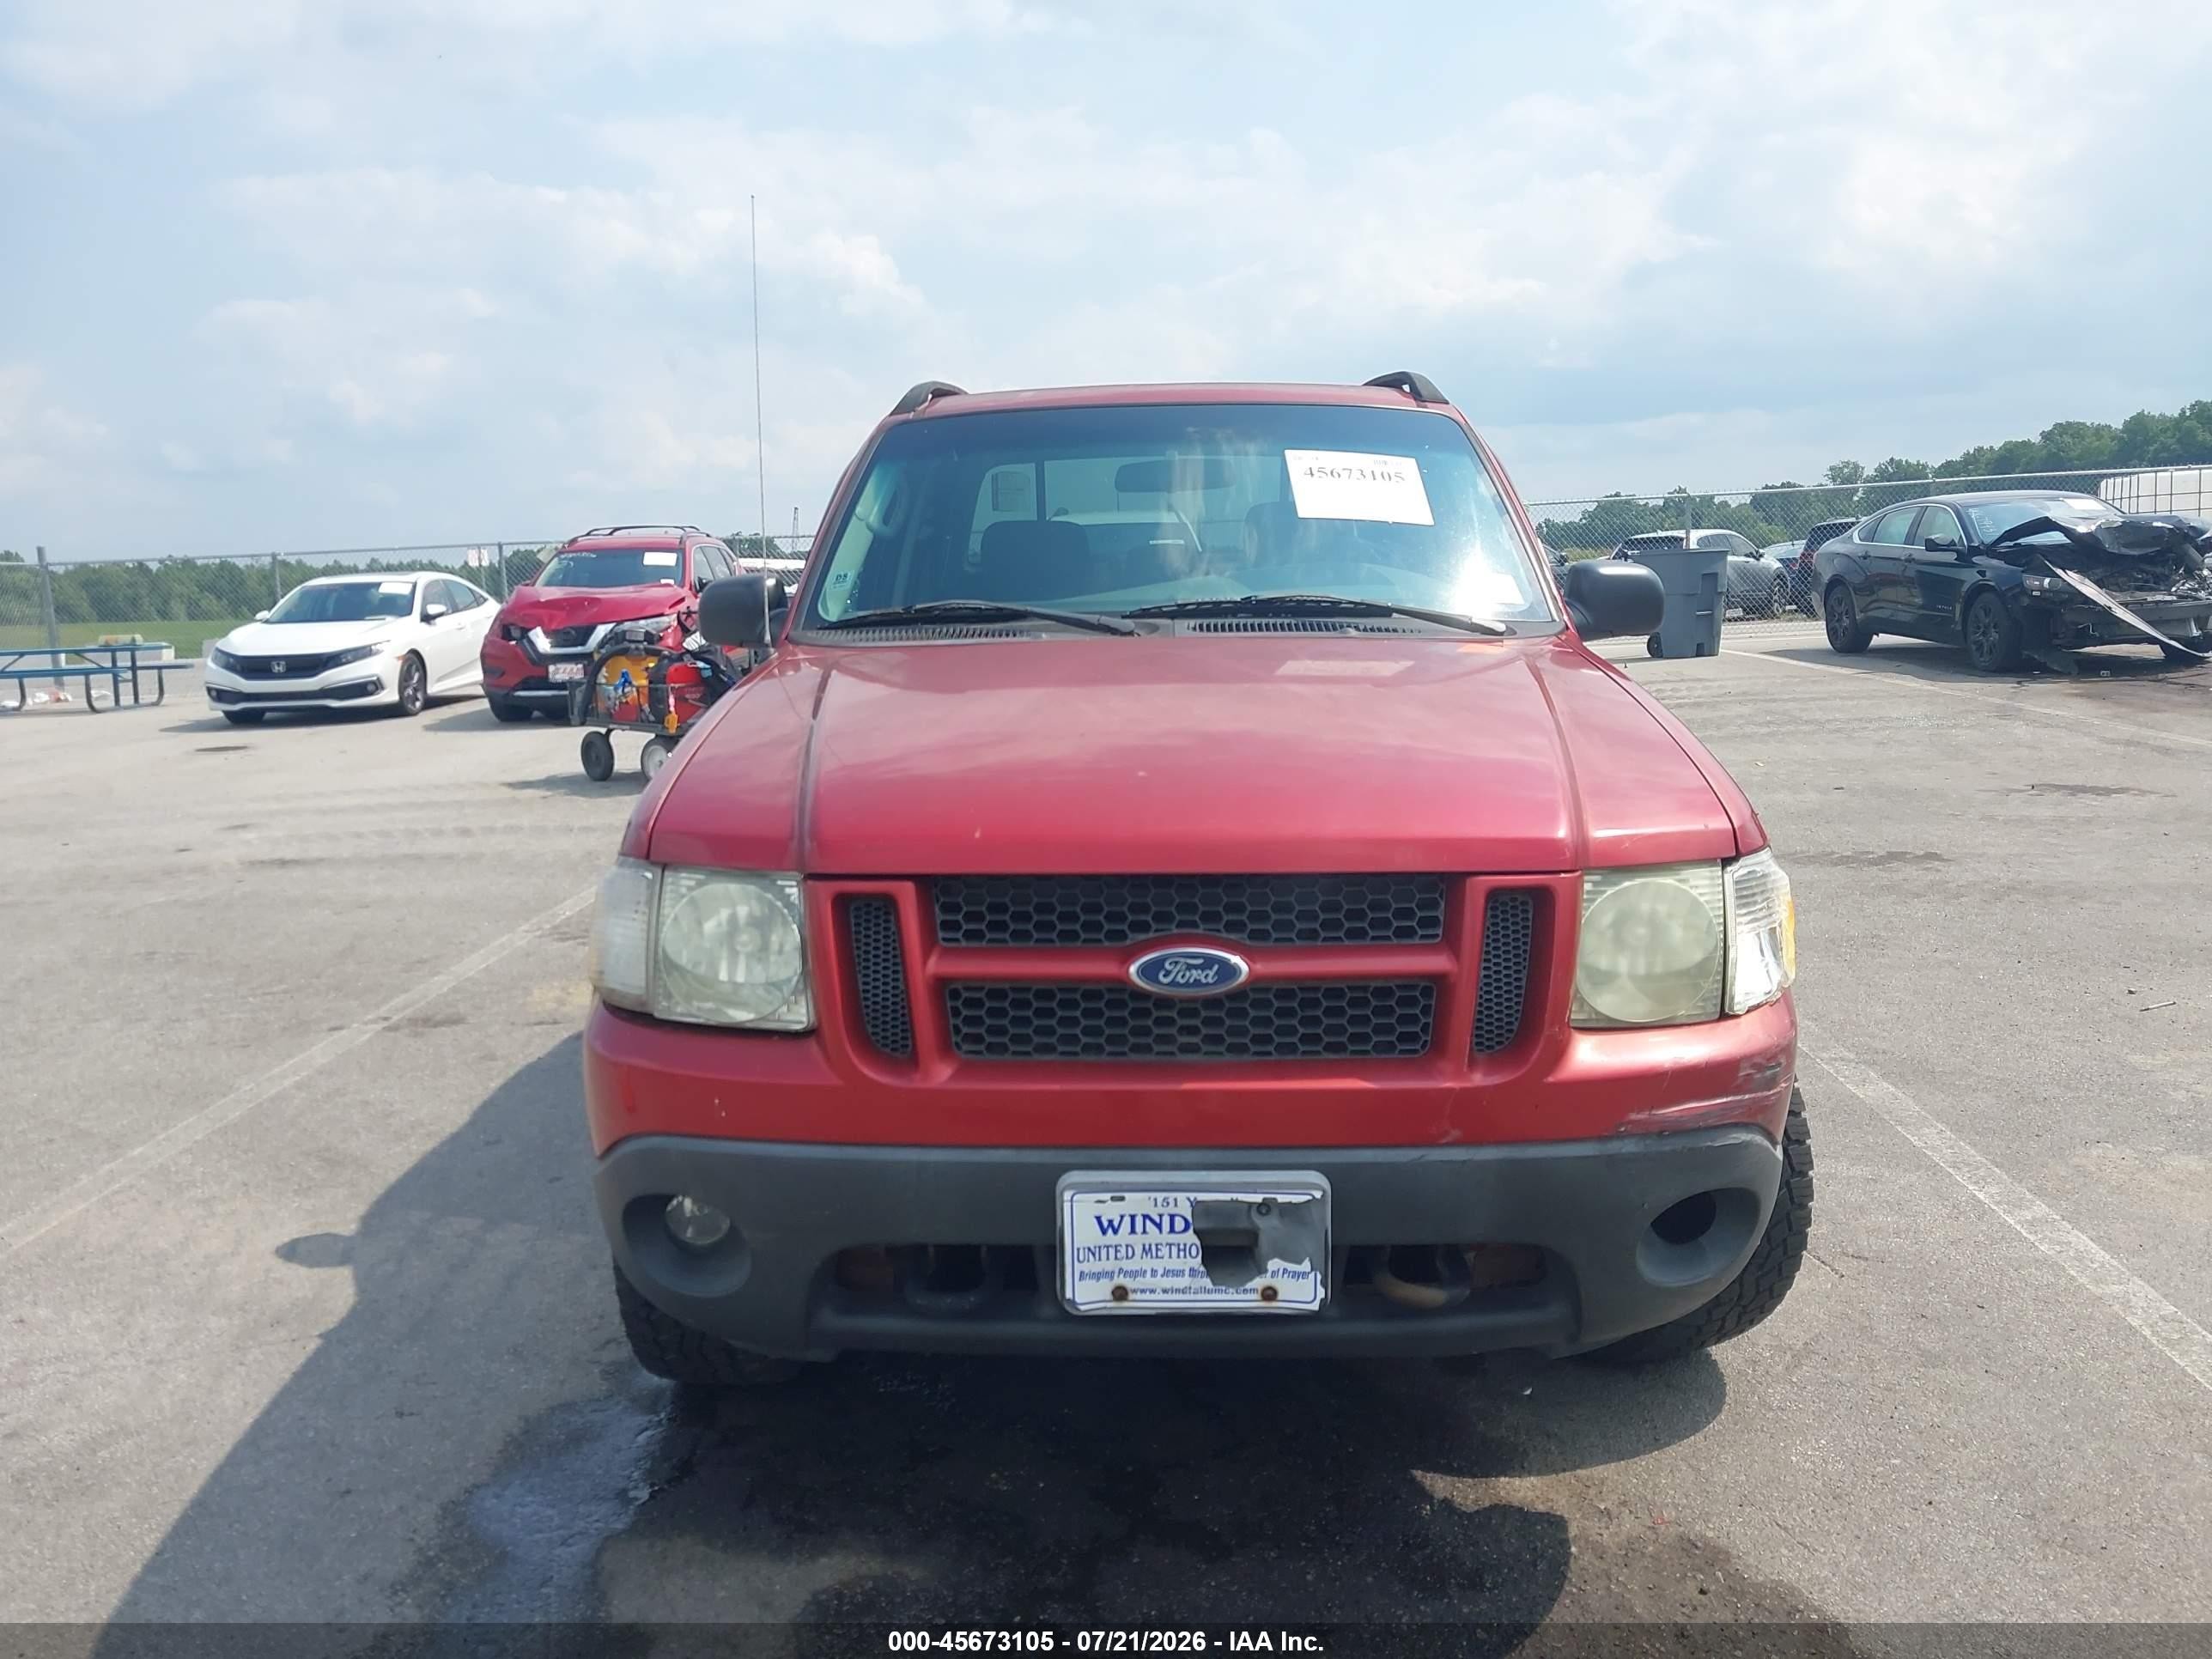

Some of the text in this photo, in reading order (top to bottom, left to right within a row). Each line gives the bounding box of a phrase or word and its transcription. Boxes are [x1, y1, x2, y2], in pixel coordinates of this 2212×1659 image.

[1304, 466, 1406, 483] 45673105
[1158, 956, 1219, 985] Ford
[1093, 1212, 1193, 1237] WIND
[1077, 1243, 1200, 1264] UNITED METHO
[1079, 1268, 1115, 1282] Bringing
[1117, 1267, 1148, 1280] People
[1150, 1267, 1158, 1278] to
[1161, 1267, 1186, 1279] Jesus
[1271, 1267, 1280, 1279] of
[1282, 1267, 1310, 1281] Prayer
